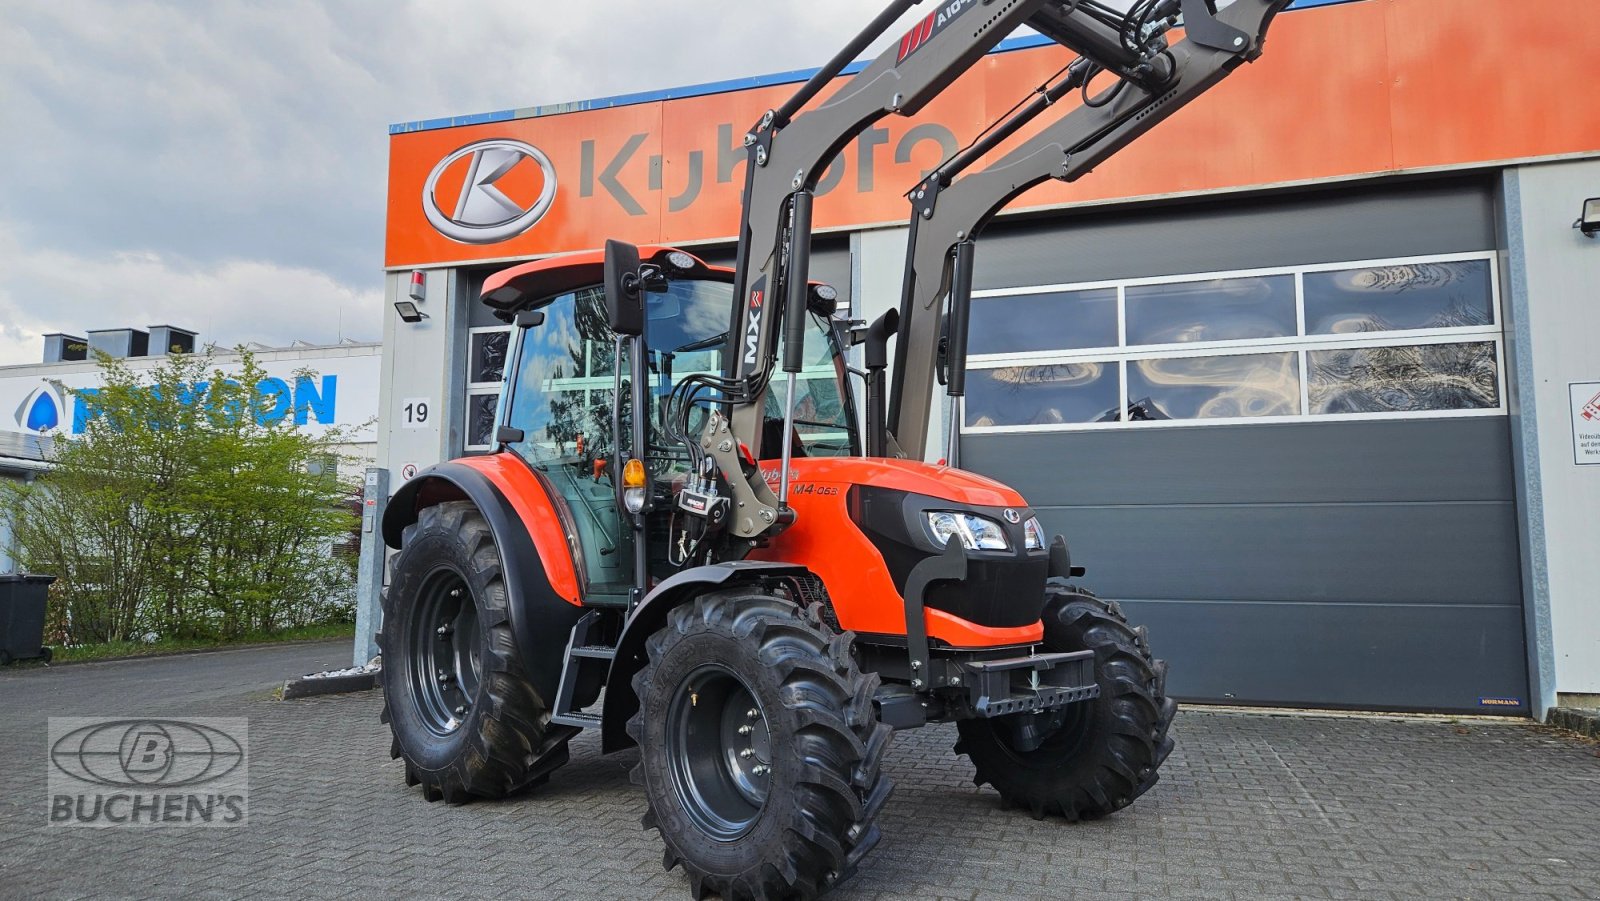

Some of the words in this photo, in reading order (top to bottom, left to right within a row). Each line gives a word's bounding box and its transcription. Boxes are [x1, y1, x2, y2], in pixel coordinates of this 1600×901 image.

[579, 122, 960, 216] Kubta
[404, 402, 428, 423] 19
[793, 484, 838, 496] M4-063
